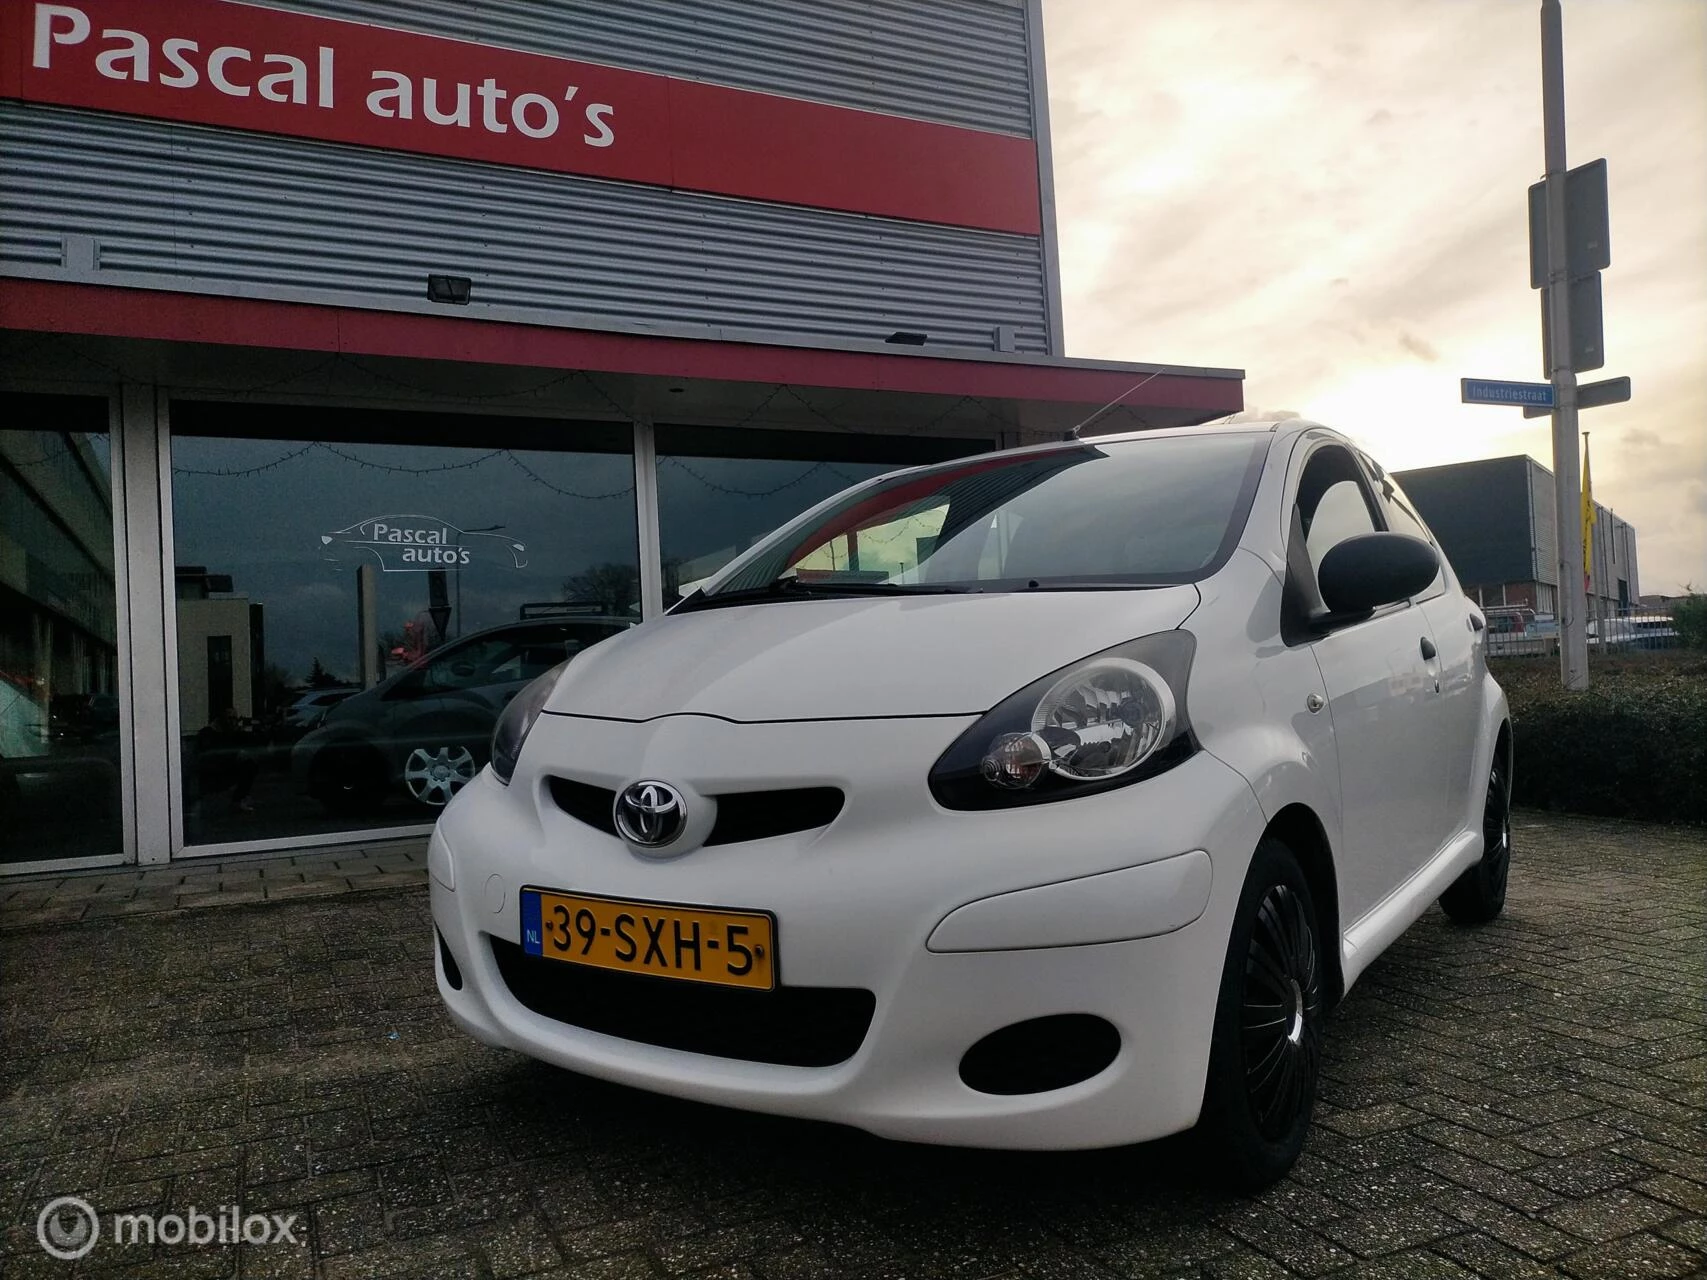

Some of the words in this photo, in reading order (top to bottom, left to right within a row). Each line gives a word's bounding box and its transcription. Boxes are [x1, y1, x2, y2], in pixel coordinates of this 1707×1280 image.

[32, 2, 334, 109] Pascal
[366, 69, 616, 148] auto's
[1472, 384, 1547, 402] Industriestraat
[373, 523, 448, 545] Pascal
[402, 547, 471, 565] auto's
[526, 928, 541, 945] NL
[553, 904, 754, 977] 39-SXH-5
